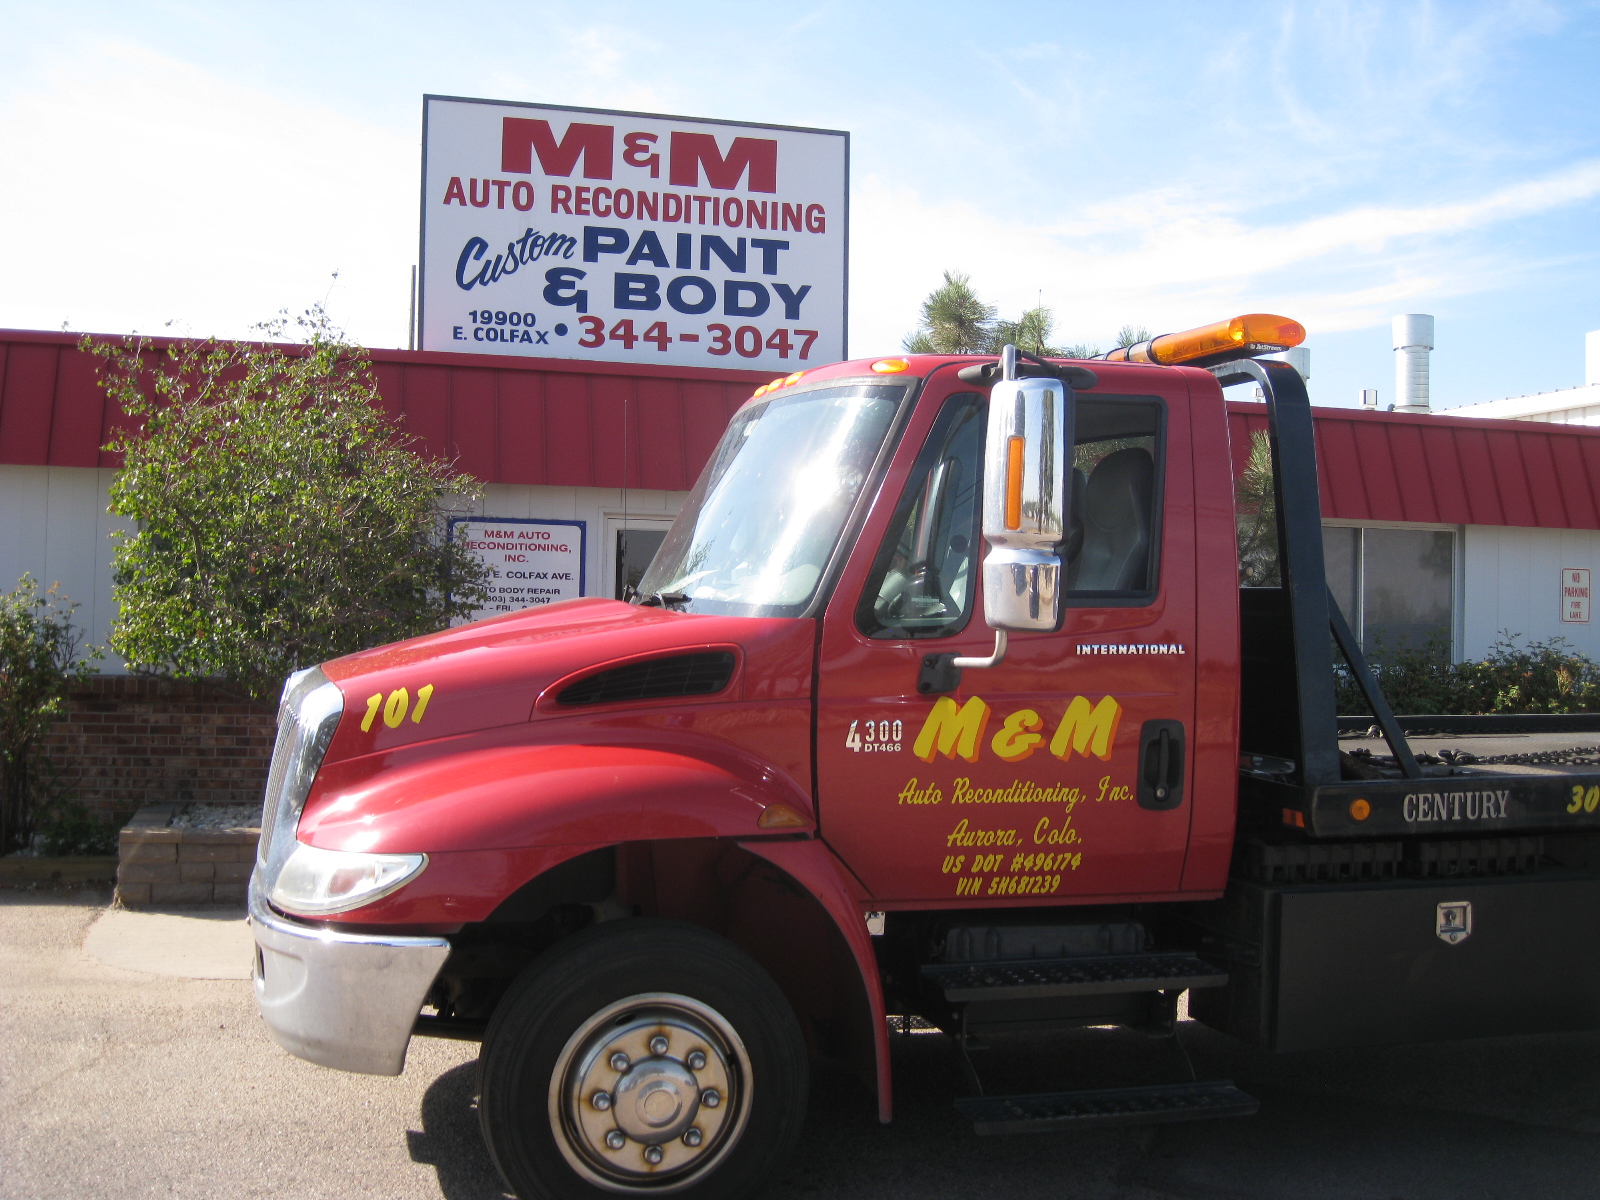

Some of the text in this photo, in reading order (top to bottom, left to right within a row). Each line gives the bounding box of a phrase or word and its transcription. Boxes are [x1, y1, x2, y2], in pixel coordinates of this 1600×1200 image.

[501, 116, 778, 194] M&M
[443, 176, 826, 234] AUTO RECONDITIONING
[455, 225, 790, 291] Custom PAINT
[542, 266, 812, 320] & BODY
[468, 309, 537, 328] 19900
[452, 325, 550, 345] E. COLFAX
[577, 315, 819, 360] 344-3047
[484, 530, 551, 540] M&M AUTO
[504, 554, 529, 563] INC.
[506, 571, 548, 580] COLFAX
[551, 572, 574, 581] AVE.
[1571, 572, 1580, 583] NO
[476, 586, 497, 594] UTO
[527, 587, 560, 595] REPAIR
[486, 595, 551, 604] 303) 344-3047
[1564, 586, 1588, 598] PARKING
[1569, 611, 1581, 619] LANE
[1571, 601, 1581, 609] FIRE
[1076, 643, 1186, 656] INTERNATIONAL
[360, 683, 434, 733] 101
[845, 719, 903, 753] 4300
[864, 743, 902, 752] DT466
[898, 775, 1134, 813] Auto Reconditioning, Inc.
[1403, 790, 1510, 823] CENTURY
[946, 816, 1083, 848] Aurora, Colo.
[941, 852, 1082, 874] US DOT #496174
[955, 874, 1061, 896] VIN 5H681239
